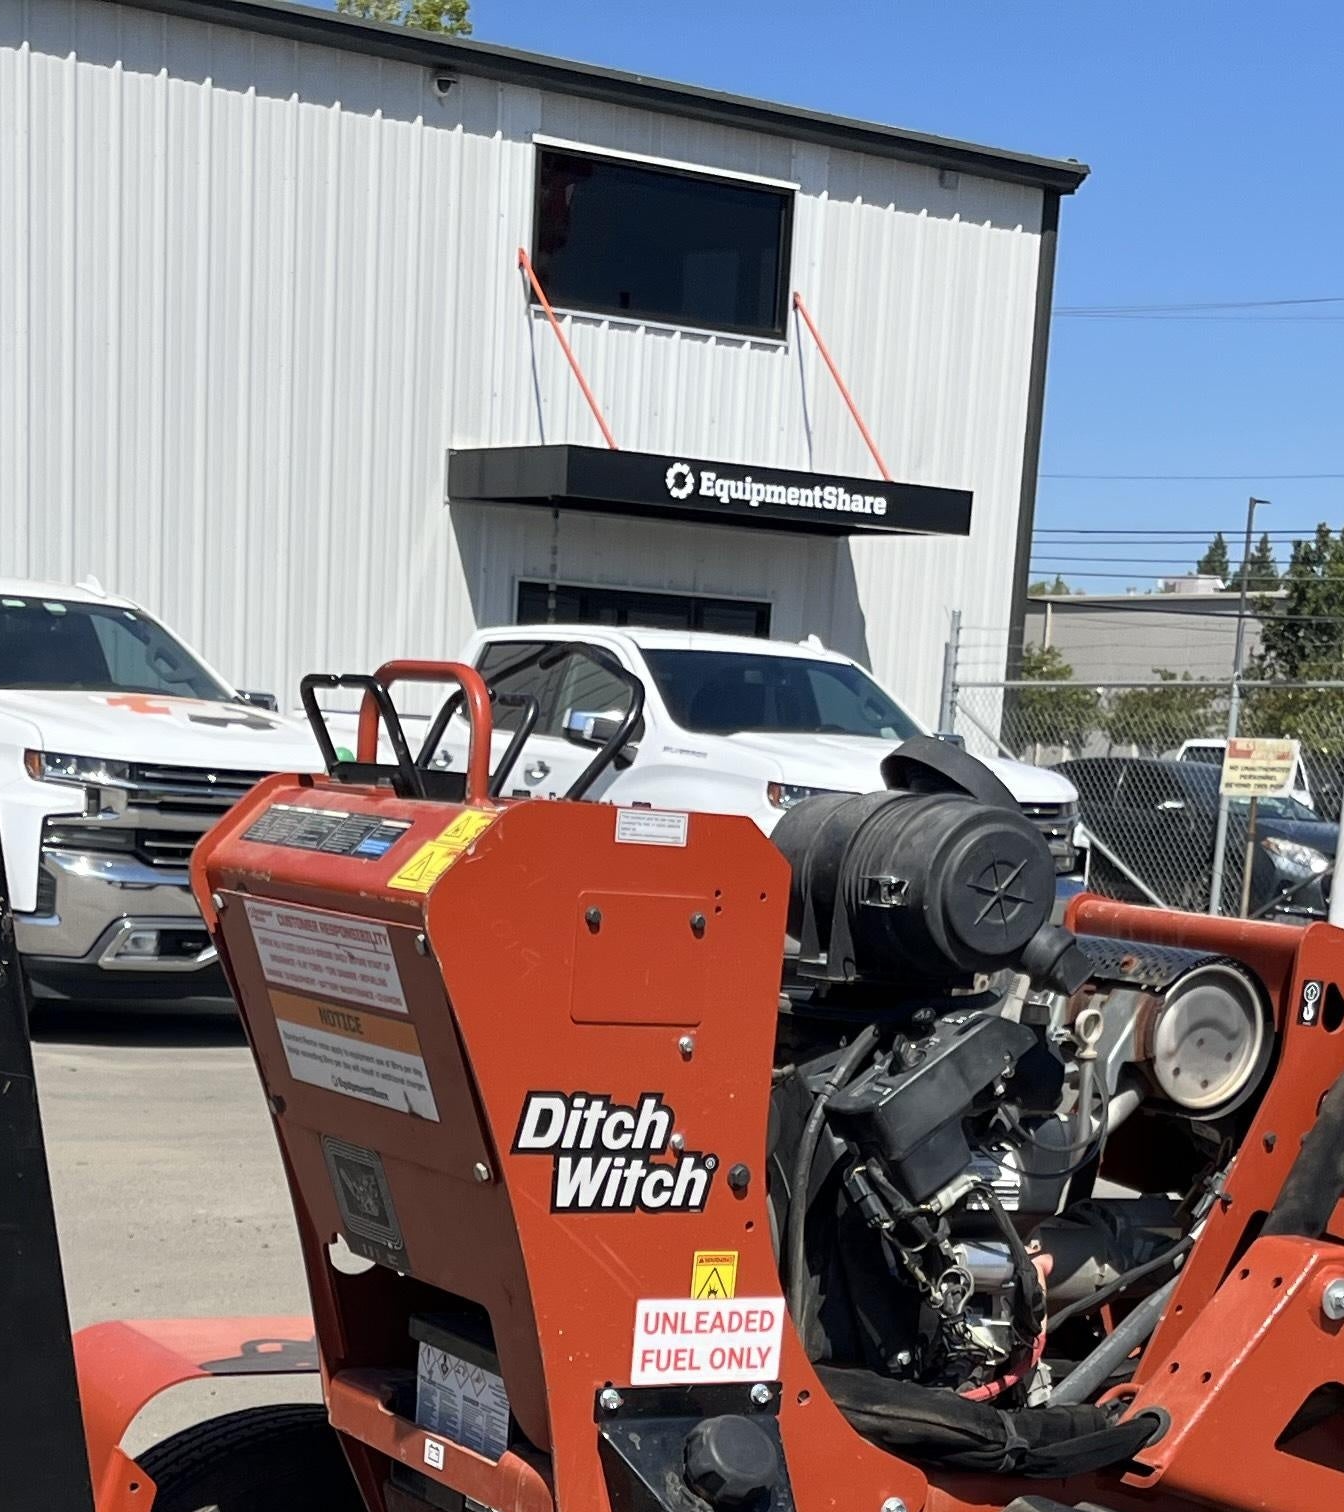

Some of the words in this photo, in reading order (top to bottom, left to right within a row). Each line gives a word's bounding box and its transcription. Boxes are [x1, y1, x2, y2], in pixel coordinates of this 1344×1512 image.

[699, 471, 887, 516] EquipmentShare
[318, 1006, 364, 1035] NOTICE
[518, 1097, 670, 1150] Ditch
[556, 1156, 708, 1208] Witch
[644, 1310, 775, 1335] UNLEADED
[640, 1348, 701, 1372] FUEL
[709, 1346, 772, 1369] ONLY
